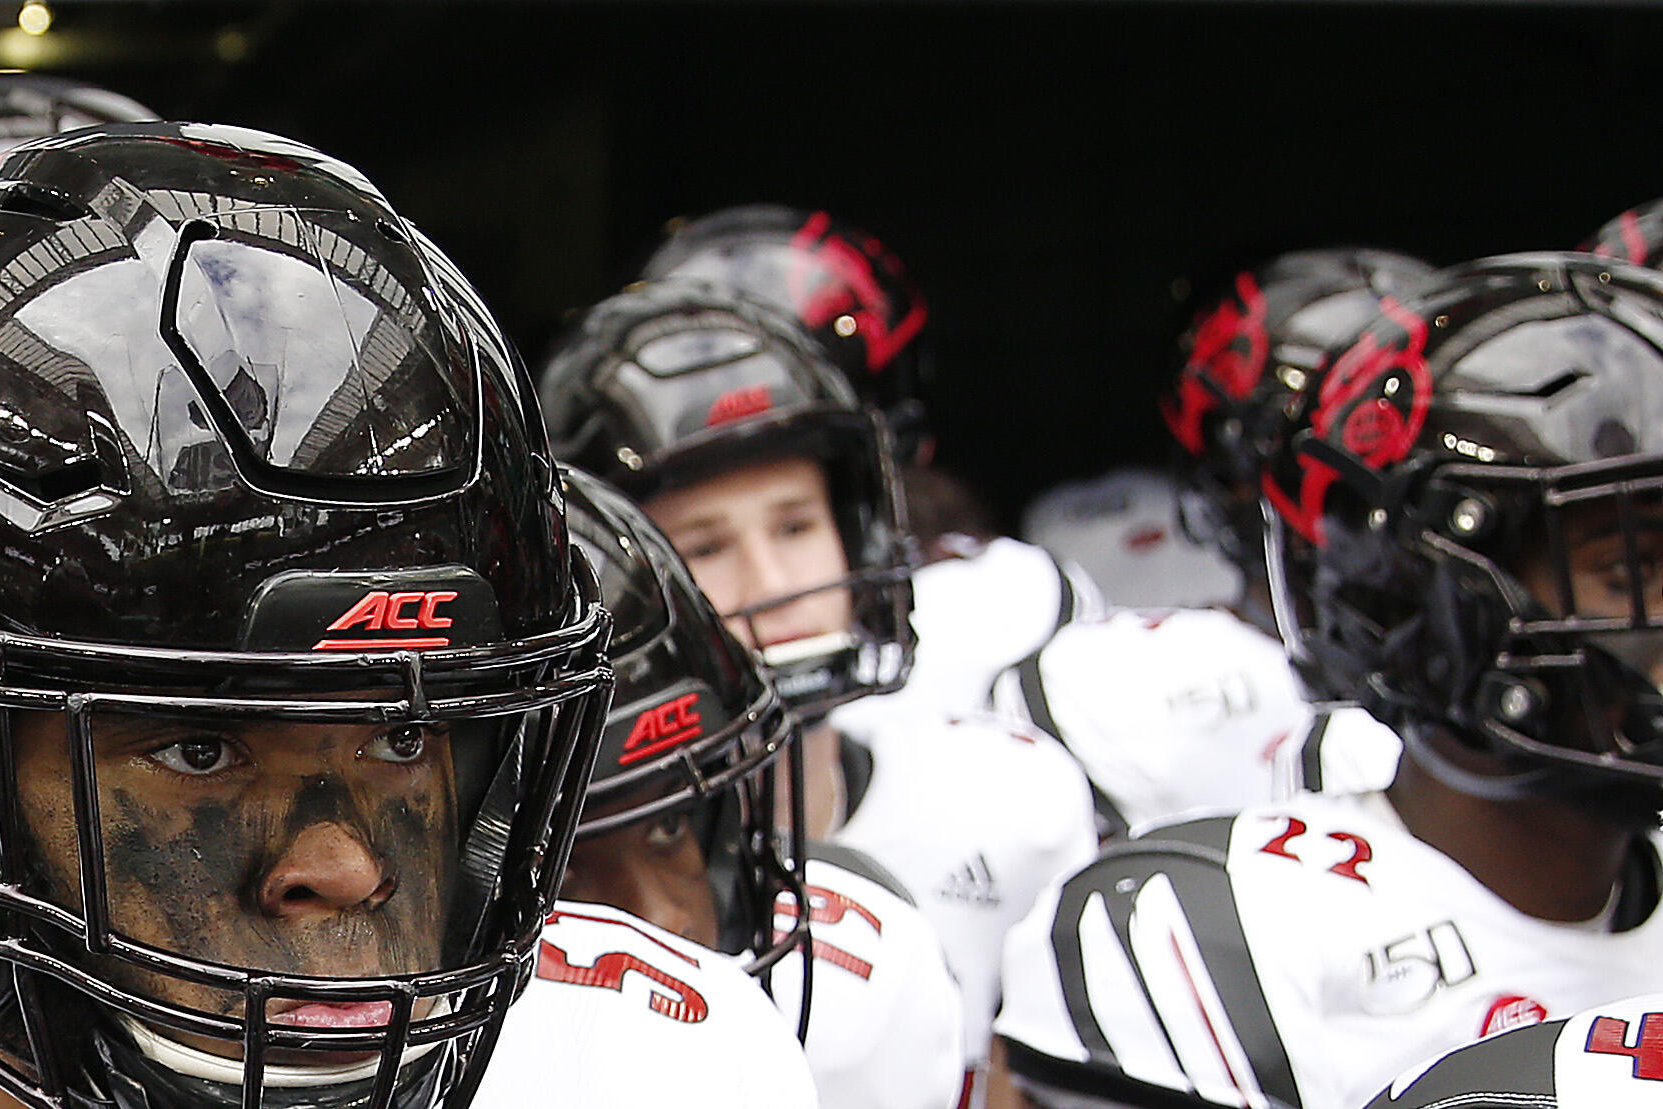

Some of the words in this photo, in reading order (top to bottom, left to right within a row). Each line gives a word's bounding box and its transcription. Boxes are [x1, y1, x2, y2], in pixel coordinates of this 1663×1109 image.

[327, 590, 459, 630] ACC
[623, 692, 701, 750] ACC
[1258, 815, 1374, 886] 22
[1365, 920, 1477, 1013] 150
